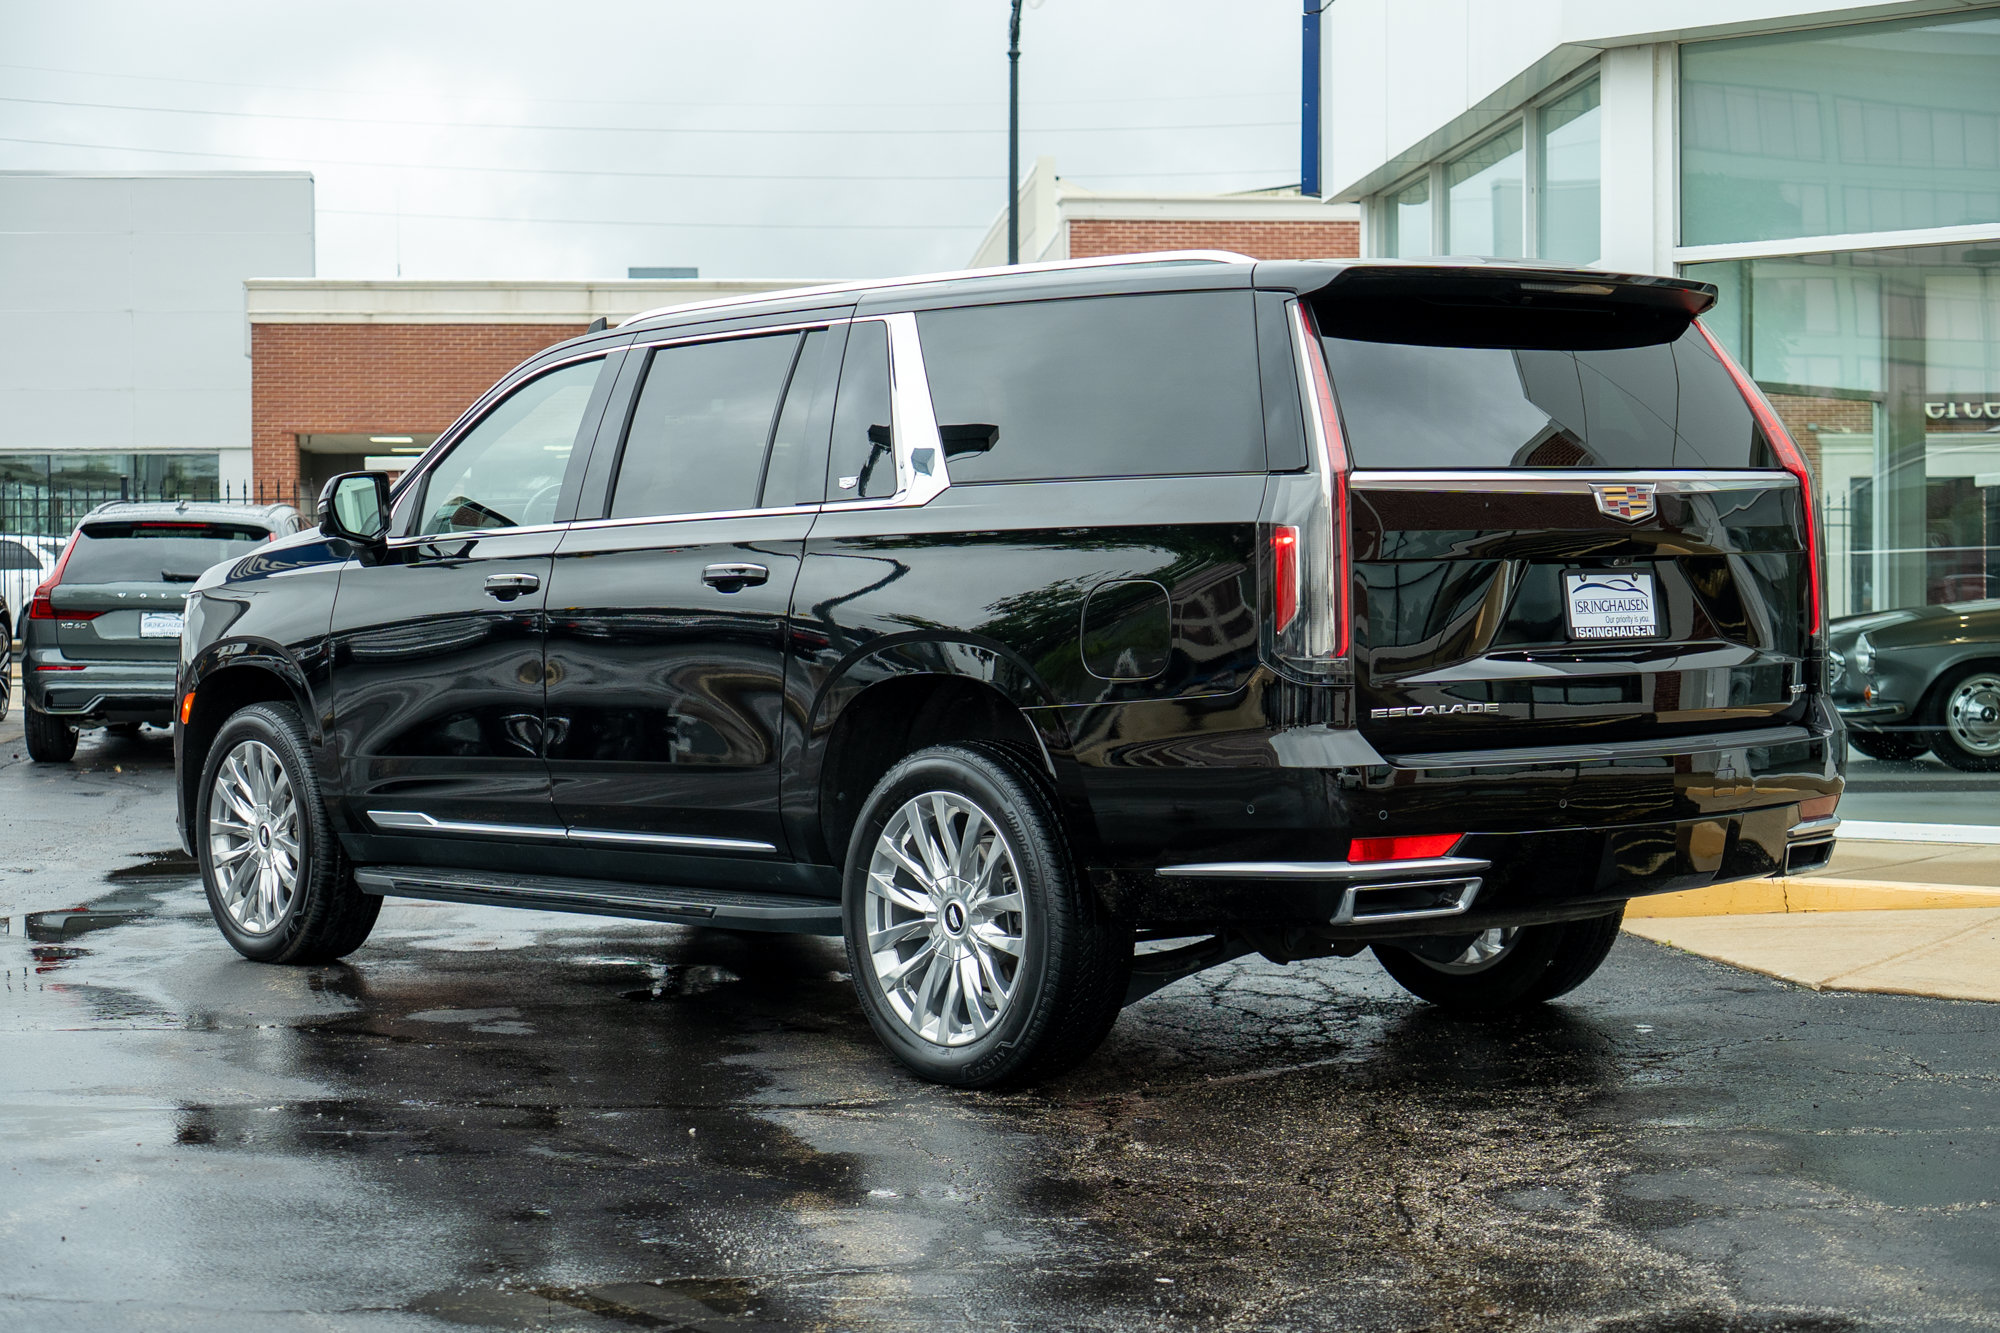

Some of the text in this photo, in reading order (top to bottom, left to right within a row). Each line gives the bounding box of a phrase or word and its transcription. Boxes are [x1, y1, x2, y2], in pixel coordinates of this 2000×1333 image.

[1575, 599, 1649, 613] ISRINGHAUSEN
[1605, 615, 1615, 624] Our
[1575, 626, 1655, 638] ISRINGHAUSEN
[1371, 703, 1500, 719] ESCALADE
